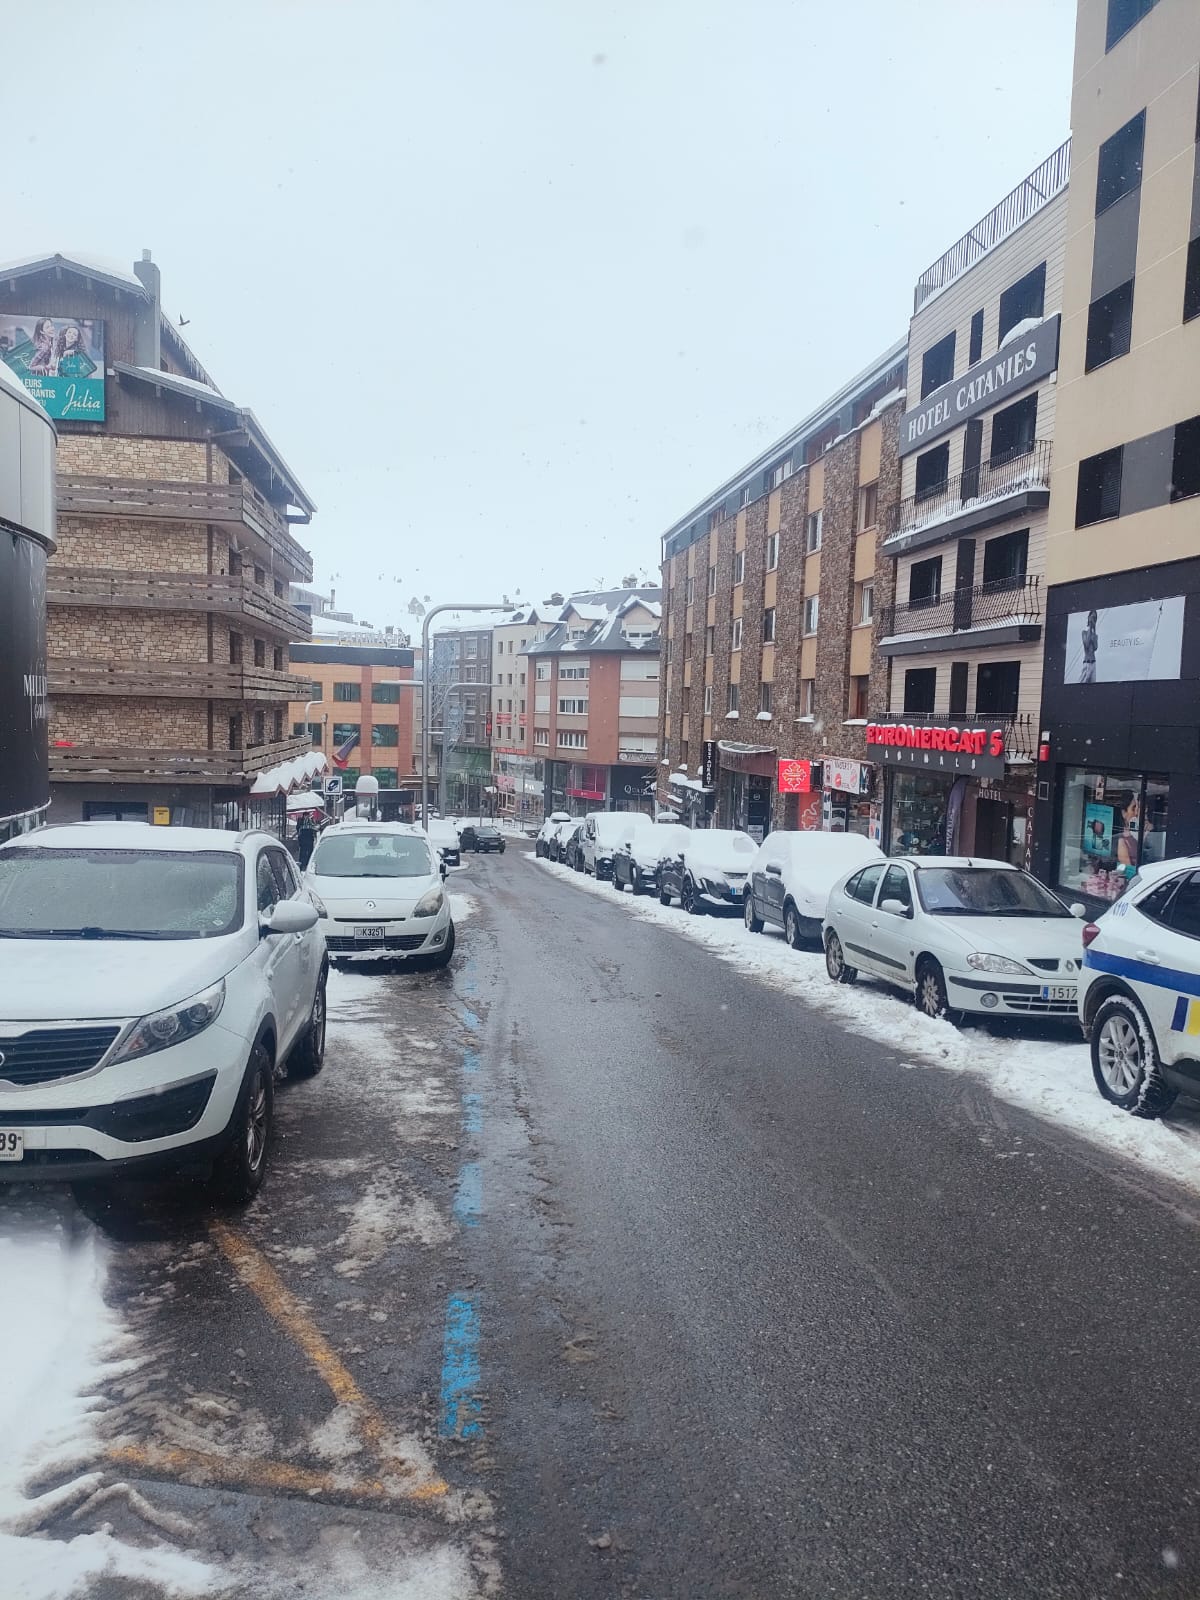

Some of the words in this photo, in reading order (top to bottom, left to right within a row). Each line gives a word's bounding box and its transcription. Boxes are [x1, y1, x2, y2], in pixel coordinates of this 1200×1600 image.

[61, 383, 101, 416] Júlia
[908, 398, 951, 442] HOTEL
[956, 342, 1037, 412] CATANIES
[1109, 639, 1133, 648] BEAUTY
[865, 723, 986, 755] EUROMERCAT
[978, 788, 1001, 802] HOTEL
[1052, 987, 1078, 999] 1517
